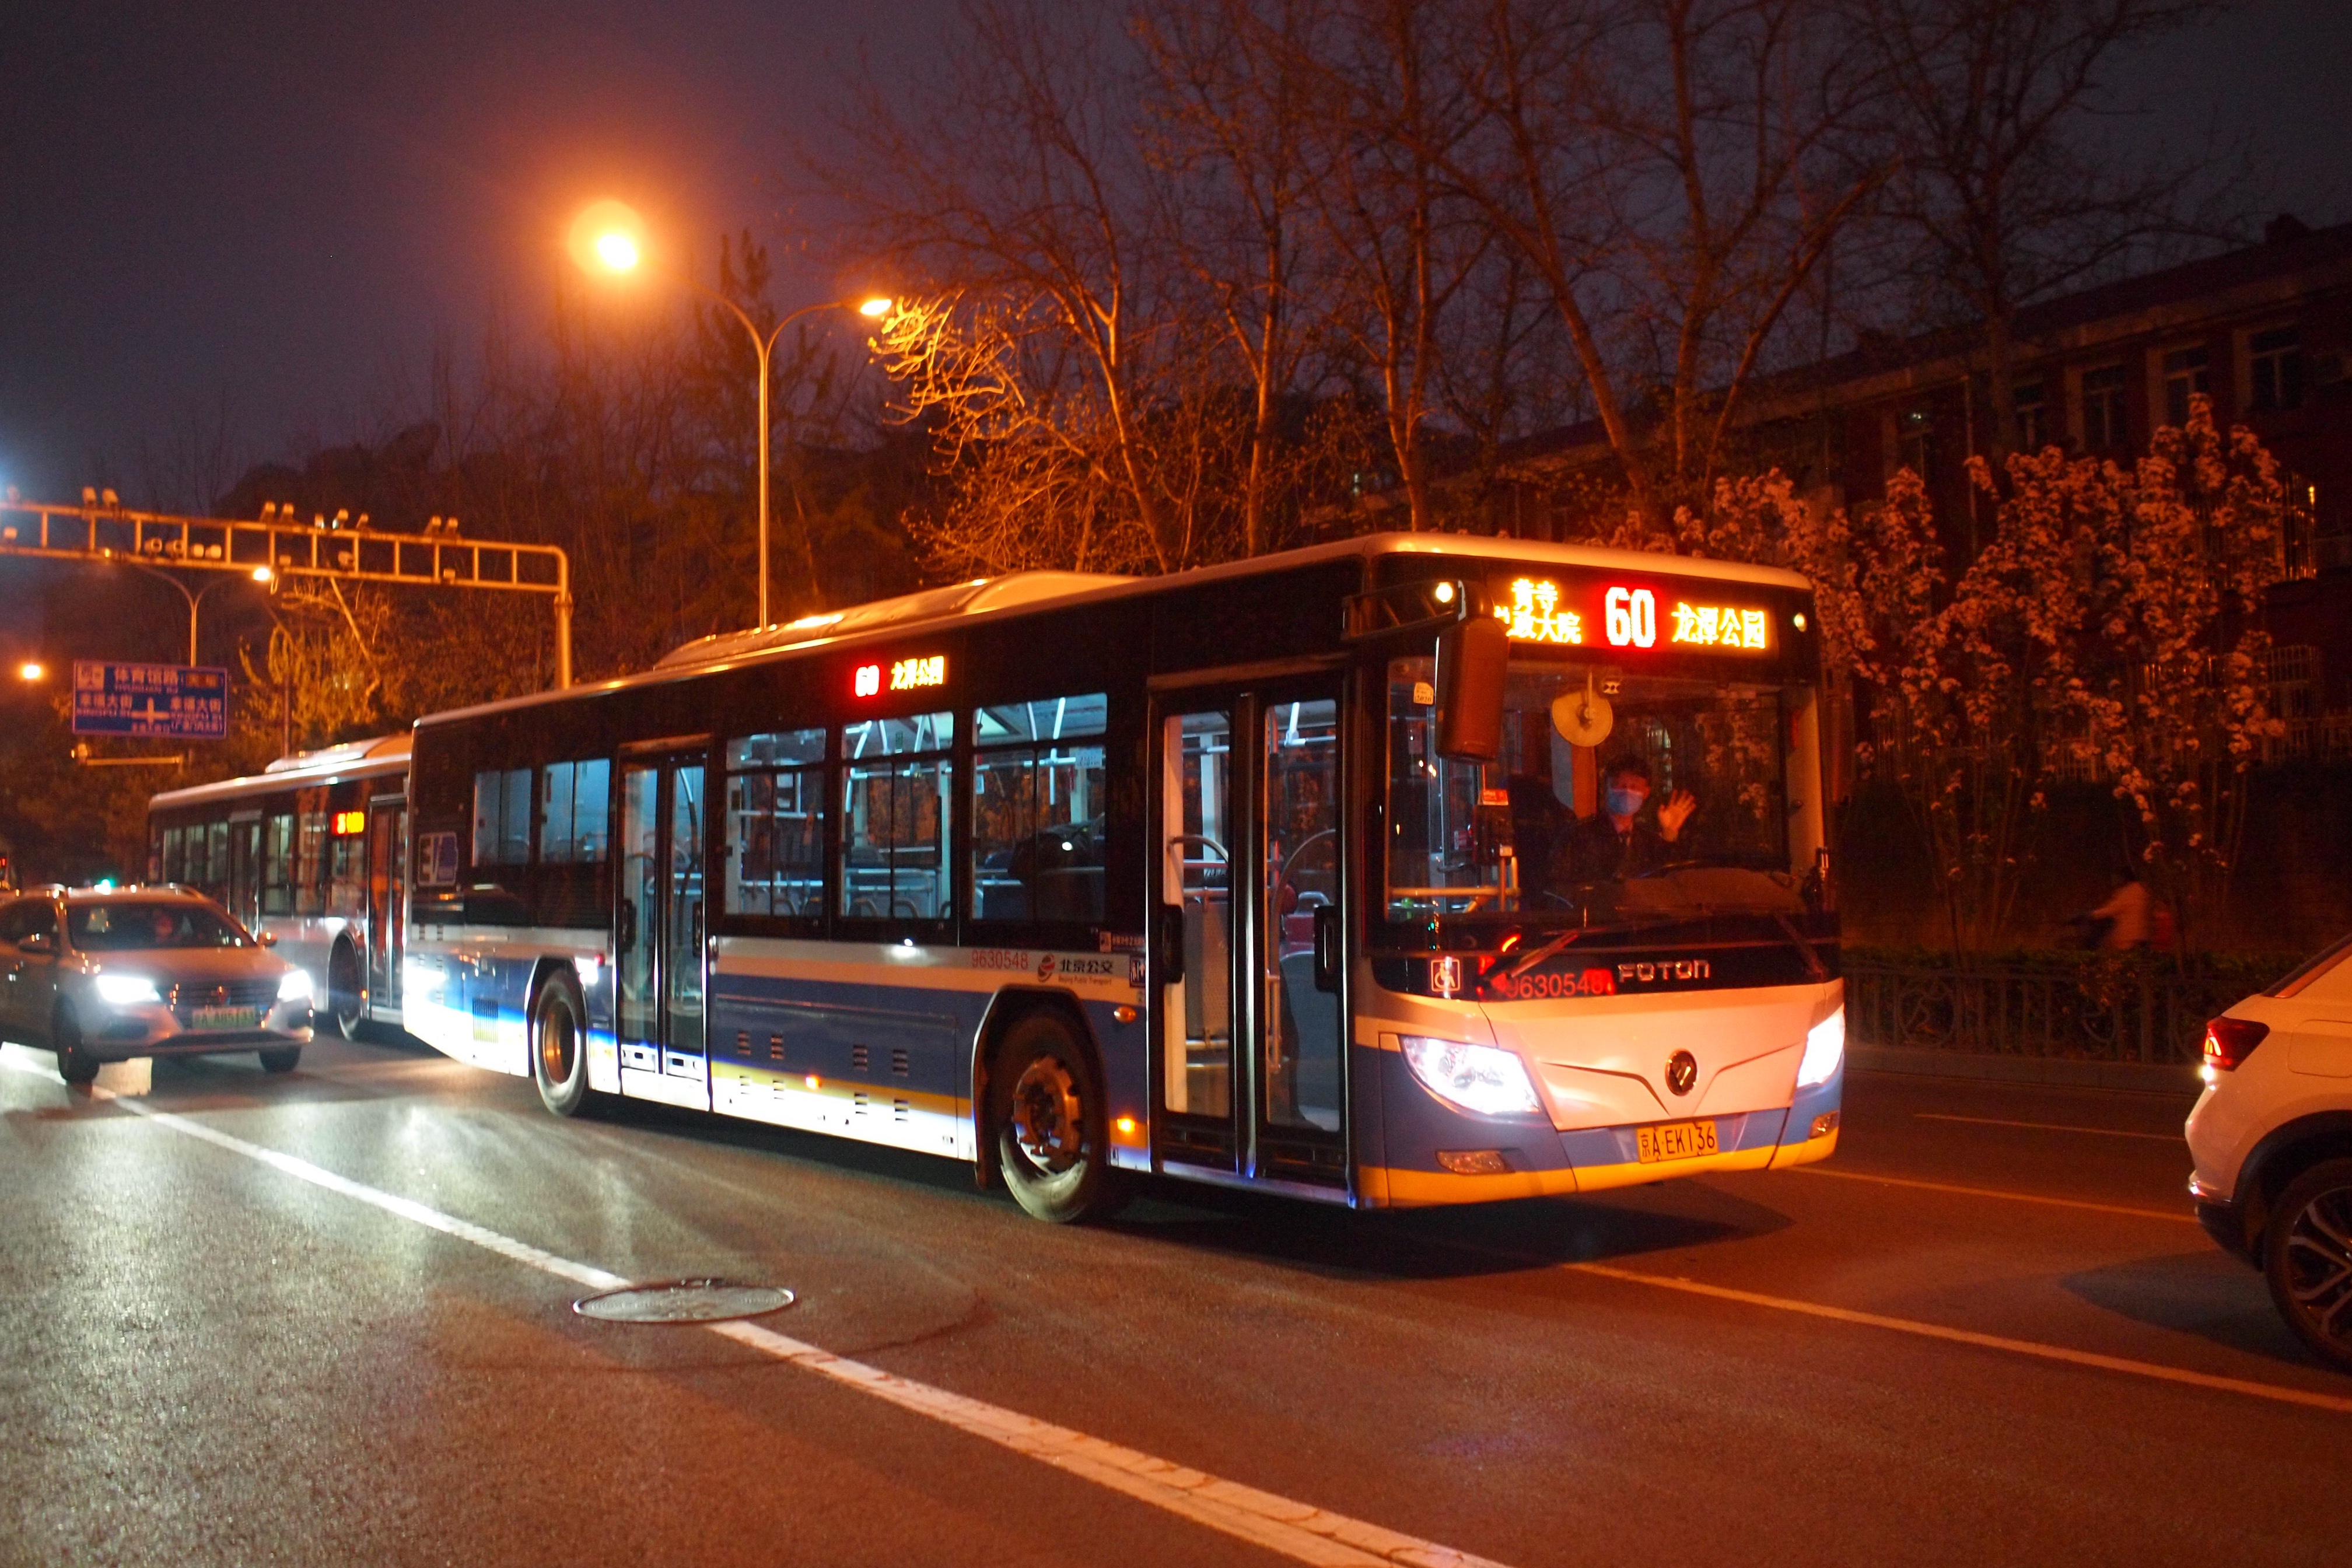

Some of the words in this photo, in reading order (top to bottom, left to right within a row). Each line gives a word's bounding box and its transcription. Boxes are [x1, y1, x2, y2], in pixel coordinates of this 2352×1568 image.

[1605, 587, 1656, 648] 60
[1671, 601, 1765, 649] 龙潭公园
[972, 950, 1028, 970] 9630548
[1060, 959, 1112, 974] 北京公交
[1618, 960, 1710, 983] FOTON
